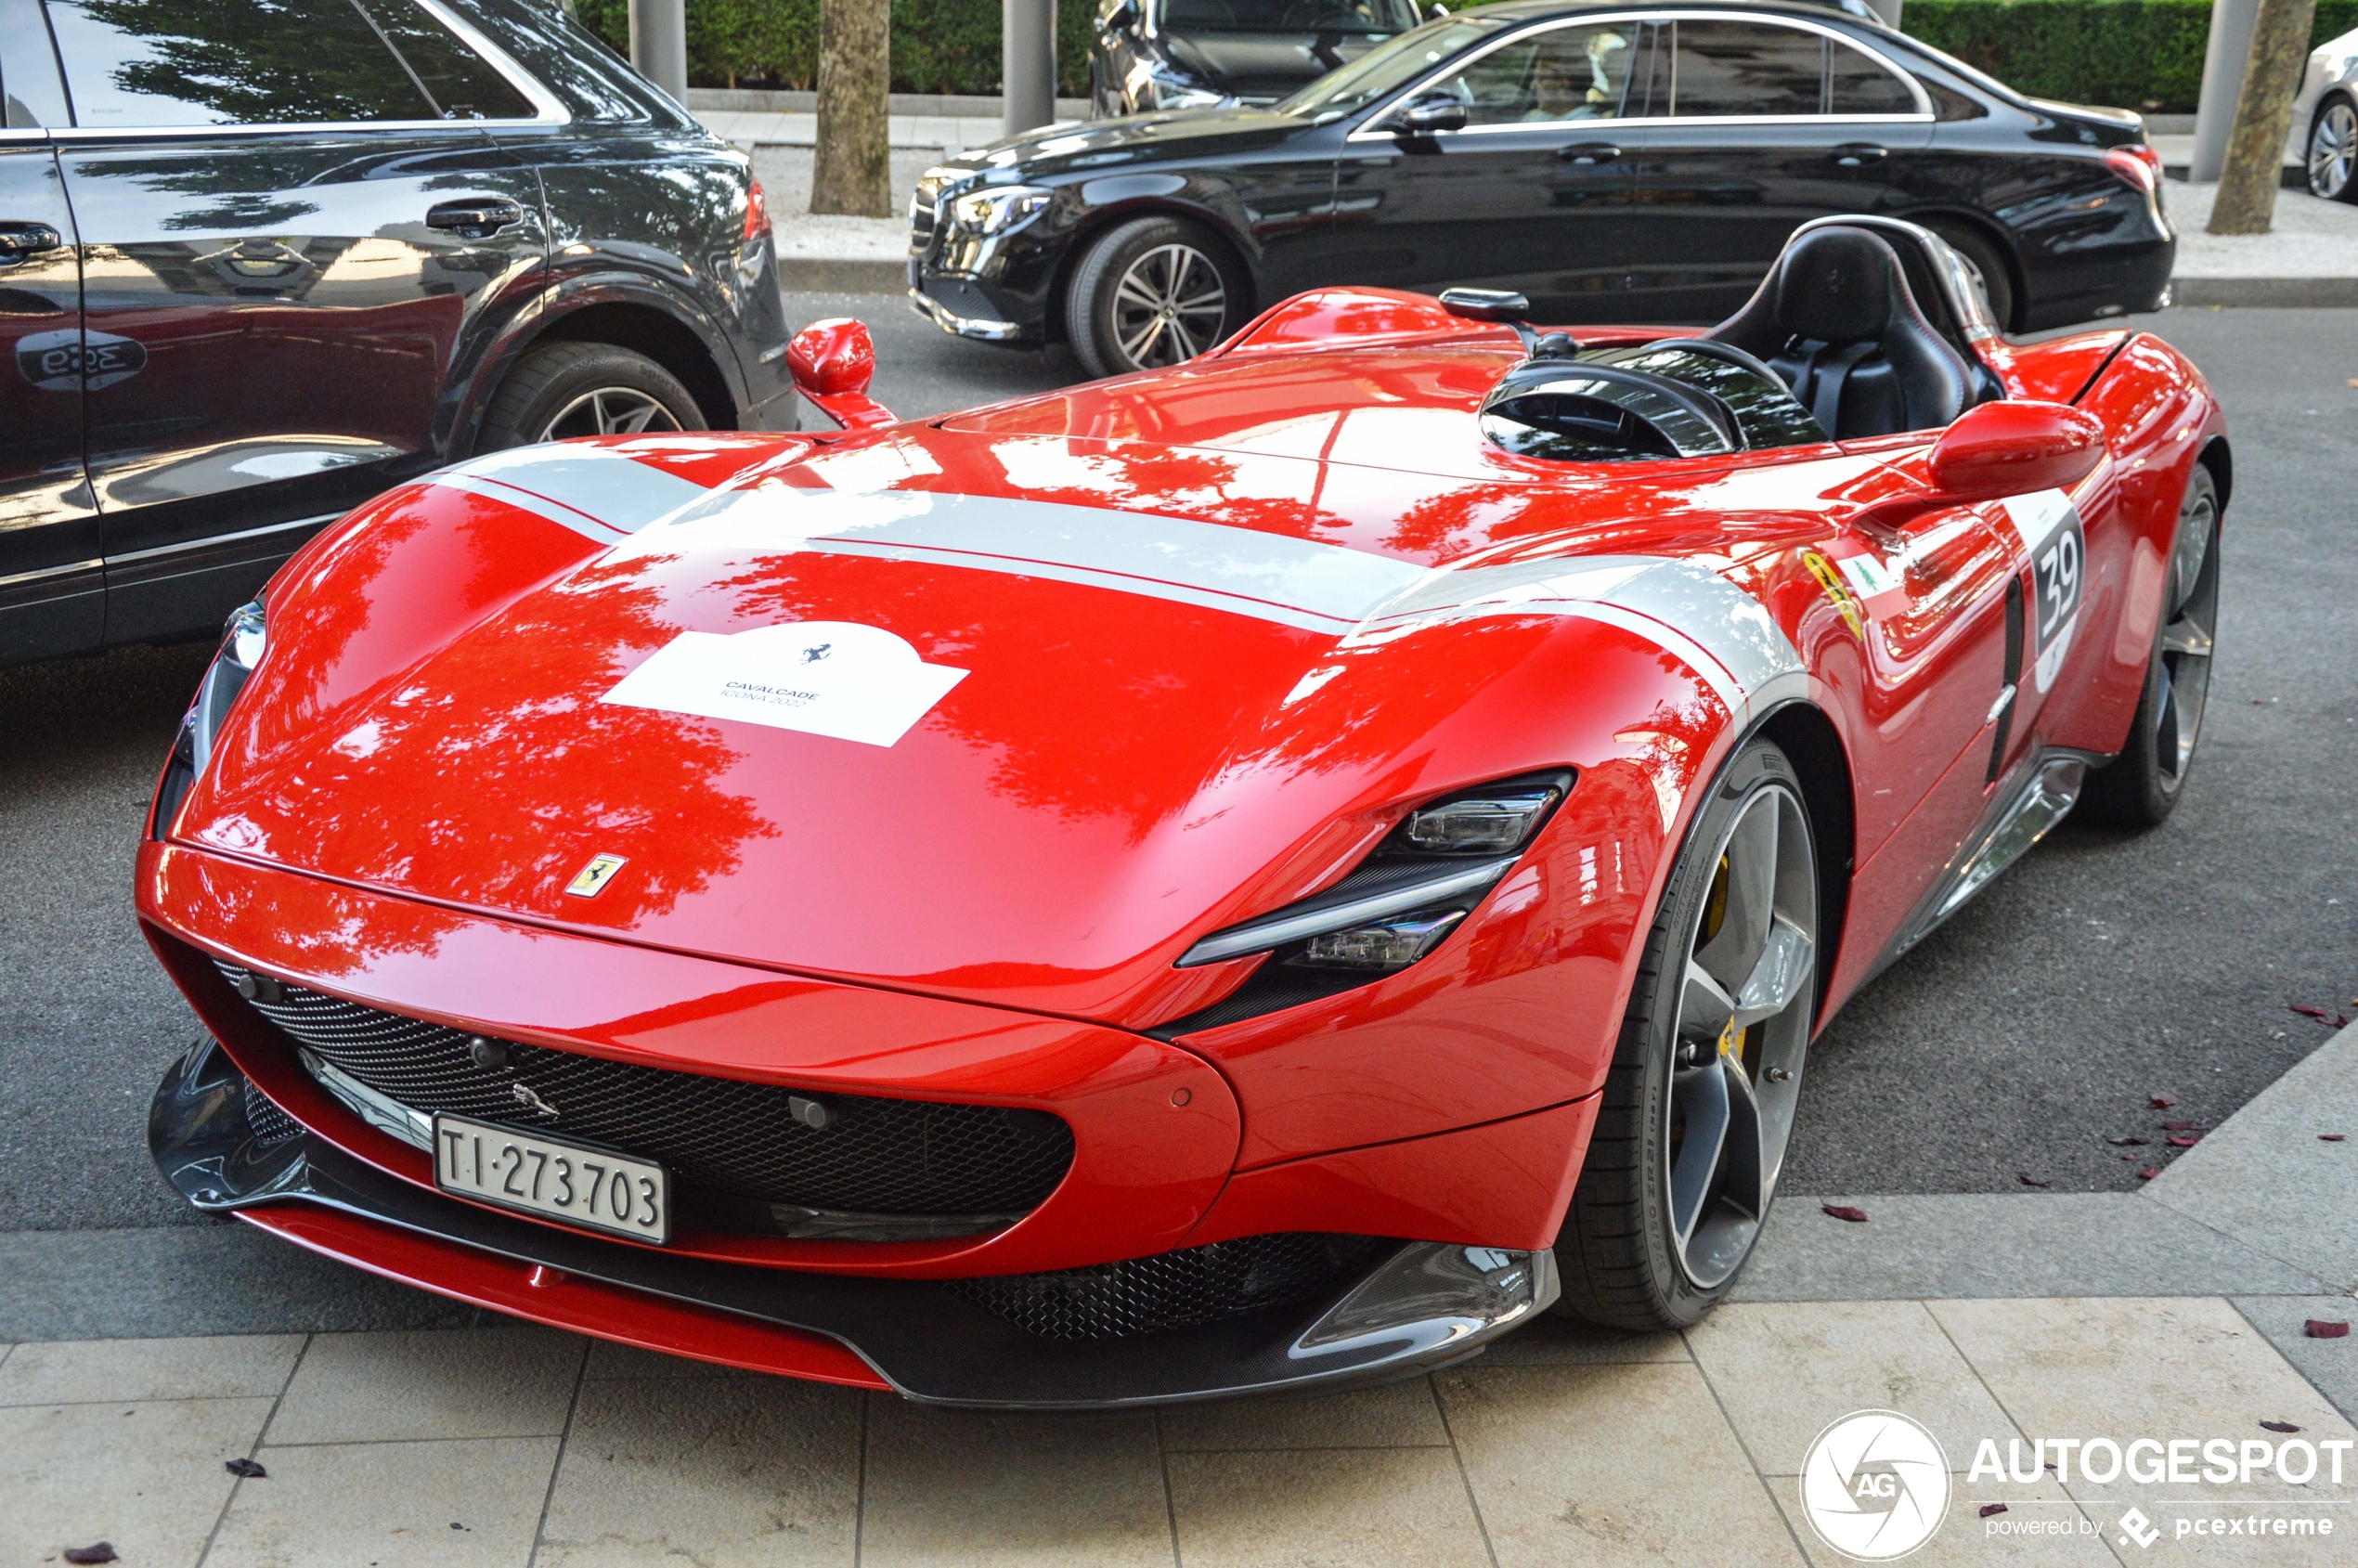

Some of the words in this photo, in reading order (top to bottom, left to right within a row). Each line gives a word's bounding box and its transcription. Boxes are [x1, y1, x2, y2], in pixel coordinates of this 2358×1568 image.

[2041, 529, 2078, 638] 39
[720, 689, 766, 702] ICONA
[769, 696, 807, 708] 2022
[726, 681, 820, 701] CAVALCADE
